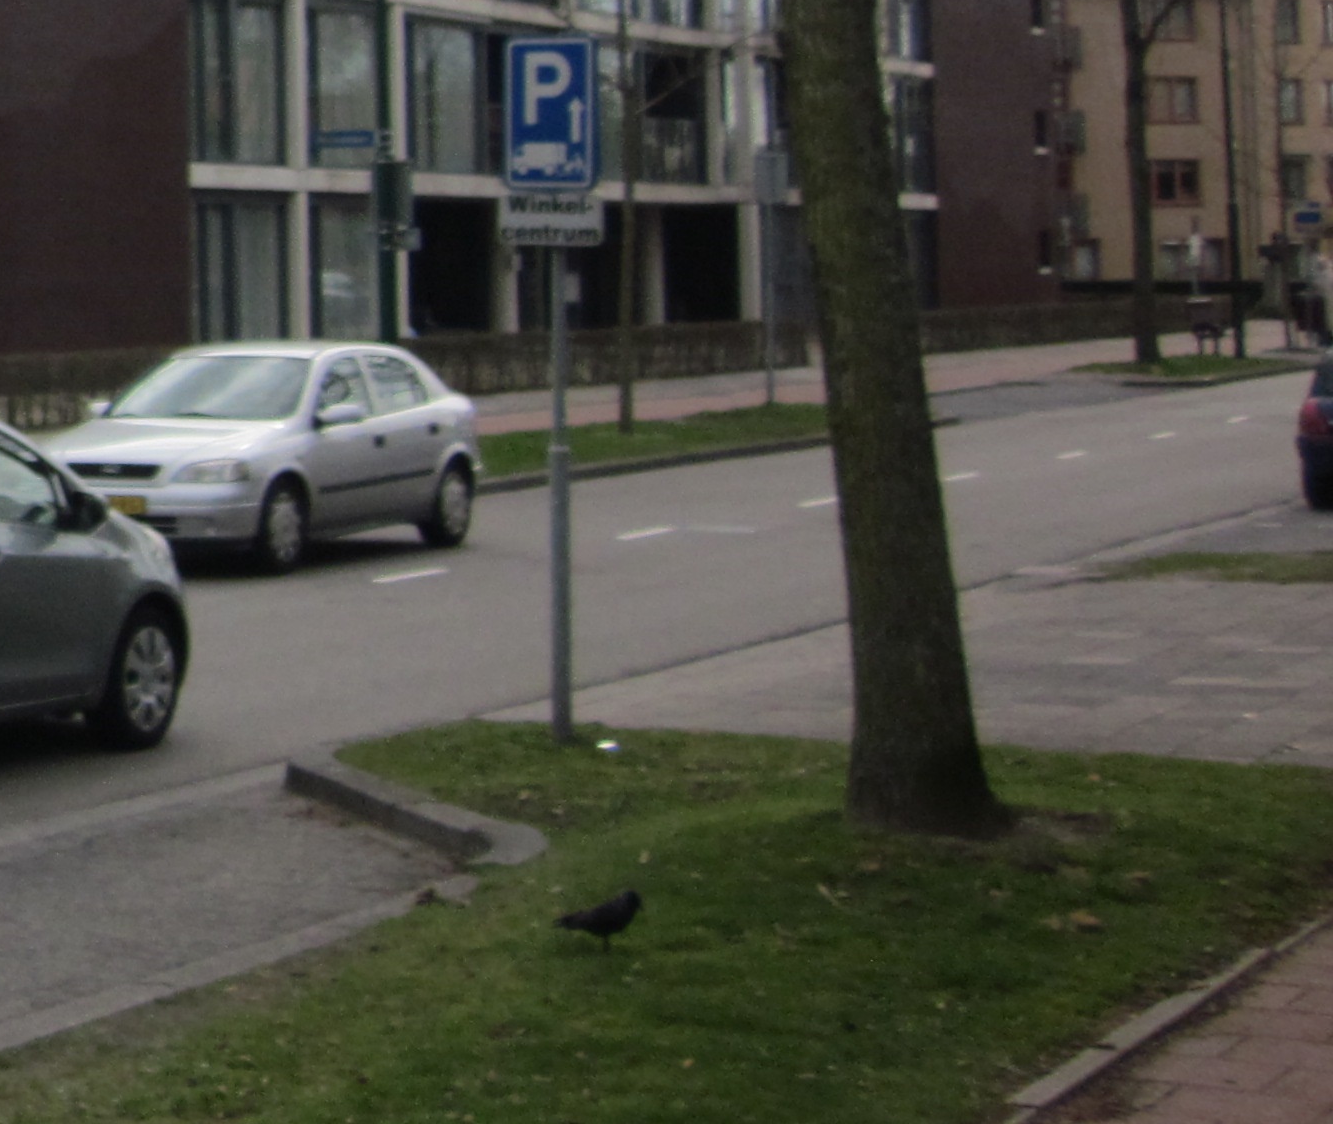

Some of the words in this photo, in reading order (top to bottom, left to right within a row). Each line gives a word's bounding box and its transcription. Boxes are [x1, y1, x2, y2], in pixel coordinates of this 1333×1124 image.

[524, 51, 571, 125] P
[508, 194, 592, 213] Winkel-
[500, 224, 599, 242] centrum
